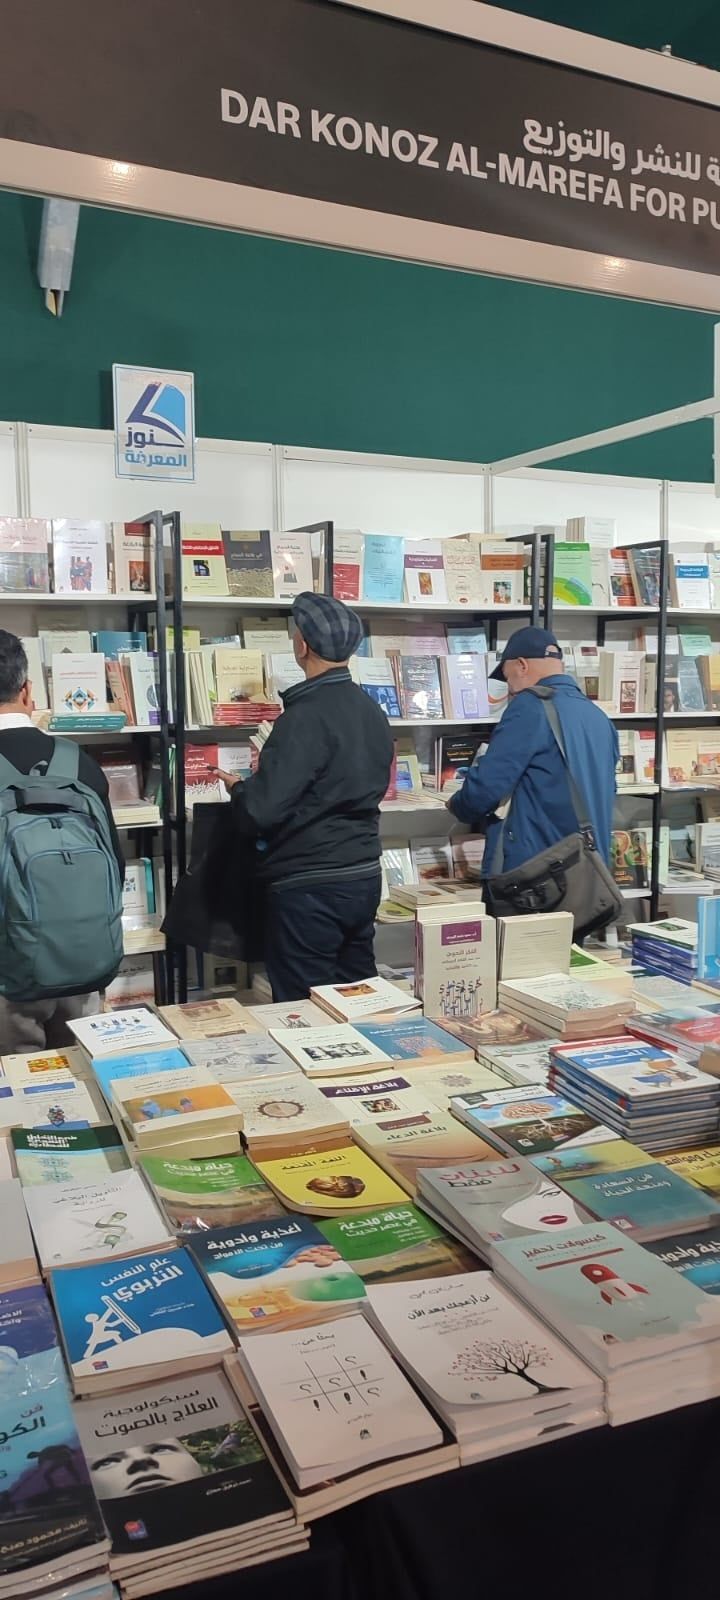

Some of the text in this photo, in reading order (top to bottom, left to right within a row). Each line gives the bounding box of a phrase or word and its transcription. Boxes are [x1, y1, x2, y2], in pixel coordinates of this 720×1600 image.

[522, 118, 626, 172] والتوزيع
[220, 87, 301, 138] DAR
[311, 109, 440, 169] KONOZ
[446, 142, 624, 209] AL-MAREFA
[629, 182, 687, 223] FOR
[631, 143, 702, 181] للنشر
[124, 449, 188, 468] المعرفة
[386, 1130, 418, 1141] الدعاء
[420, 1125, 448, 1135] بلاغة
[162, 1161, 234, 1173] حياة مبدعة
[319, 1154, 347, 1165] اللغة
[447, 1177, 493, 1188] فقط
[592, 1172, 653, 1190] فن السعادة
[604, 1186, 634, 1198] الحياة
[337, 1210, 414, 1231] حياة مبدعة
[380, 1221, 402, 1232] عصر
[403, 1217, 418, 1228] في
[345, 1226, 379, 1238] حديث
[244, 1244, 269, 1253] تحت
[555, 1234, 607, 1251] كبسولات
[100, 1257, 172, 1288] علم النفس
[111, 1264, 184, 1303] التربوي
[407, 1293, 491, 1321] لن أزعجك بعد الآن
[20, 1404, 43, 1418] فن
[102, 1389, 200, 1419] سيكولوجية
[94, 1395, 219, 1438] العلاج بالصوت
[0, 1415, 46, 1445] الكو
[26, 1527, 63, 1545] محمود
